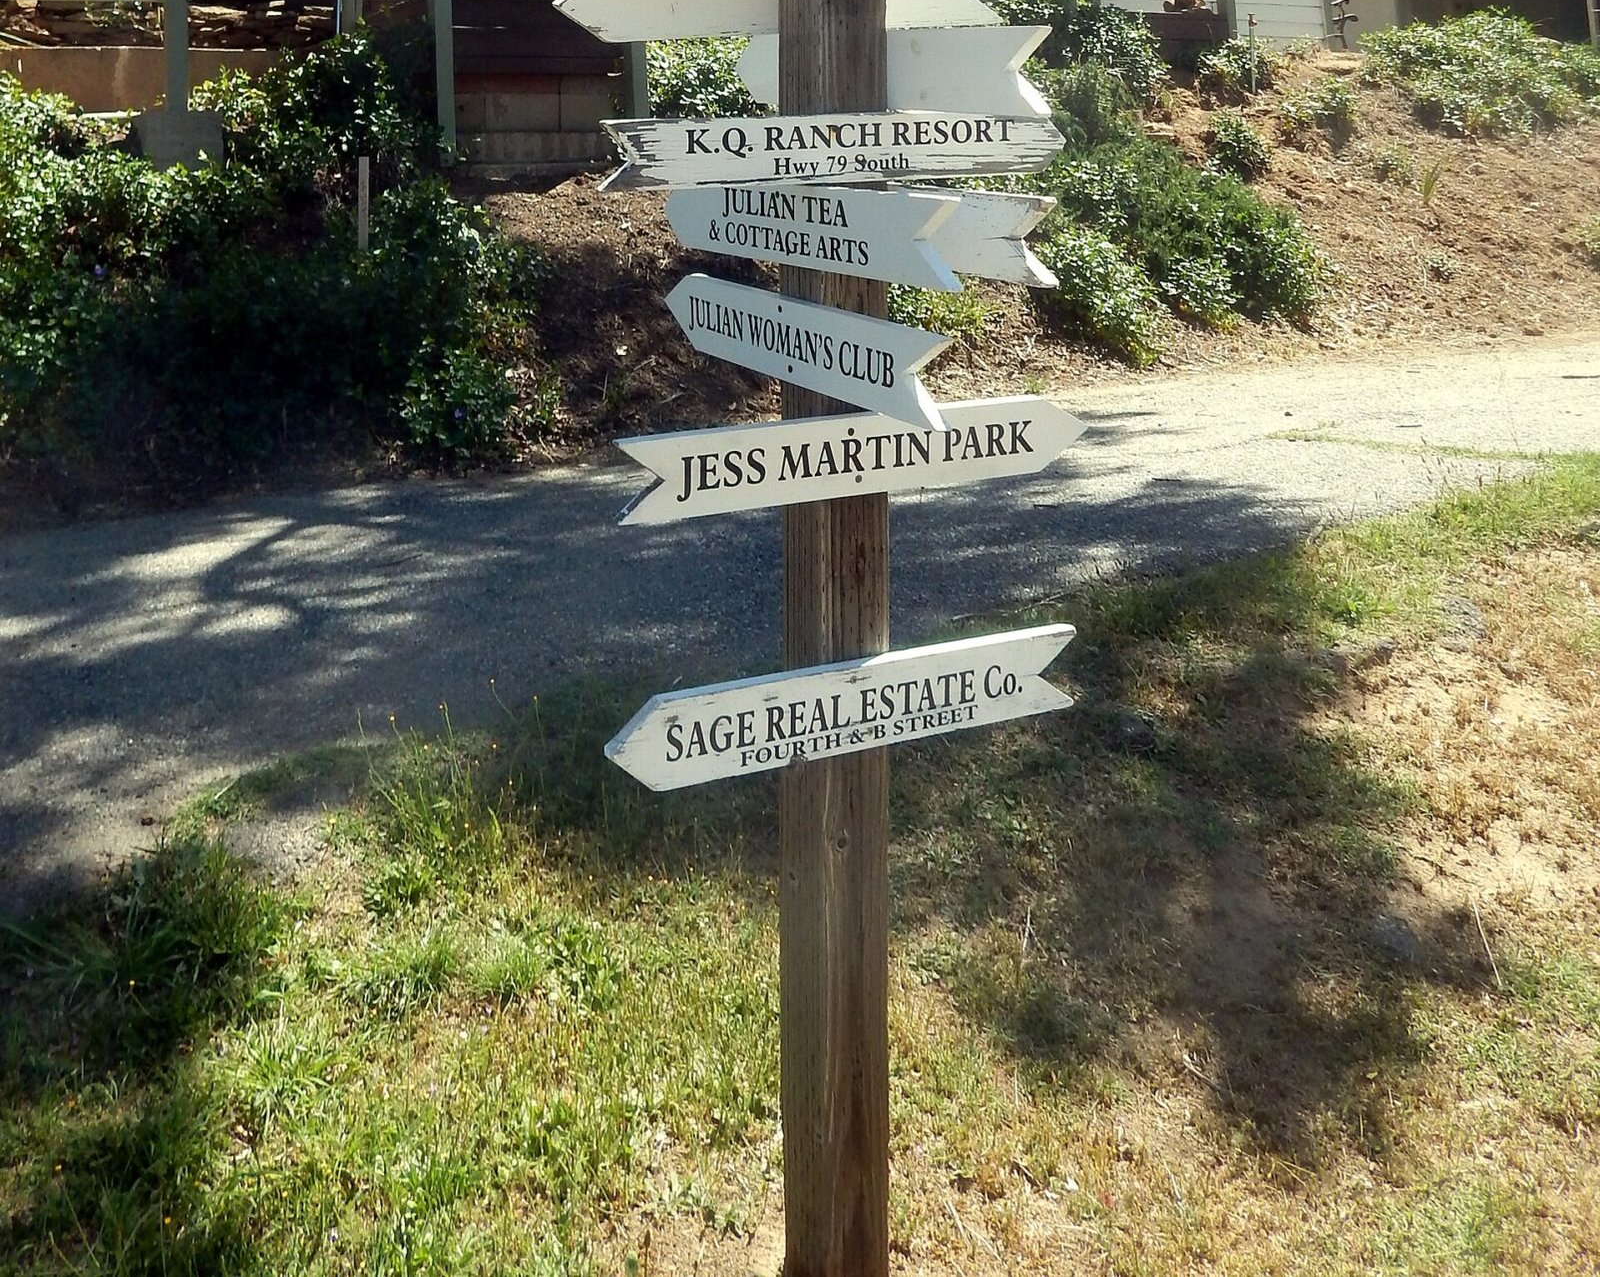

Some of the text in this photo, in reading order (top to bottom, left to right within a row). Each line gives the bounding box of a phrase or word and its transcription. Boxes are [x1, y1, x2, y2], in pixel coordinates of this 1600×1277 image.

[686, 116, 1015, 158] K.Q. RANCH RESORT
[774, 153, 910, 177] Hwy 79 South
[723, 188, 848, 227] JULIAN TEA
[709, 220, 868, 265] & COTTAGE ARTS
[689, 296, 894, 388] JULIAN WOMAN'S CLUB
[677, 420, 1033, 502] JESS MARTIN PARK
[666, 665, 1022, 763] SAGE REAL ESTATE Co.
[740, 705, 979, 768] FOURTH & B STREET
